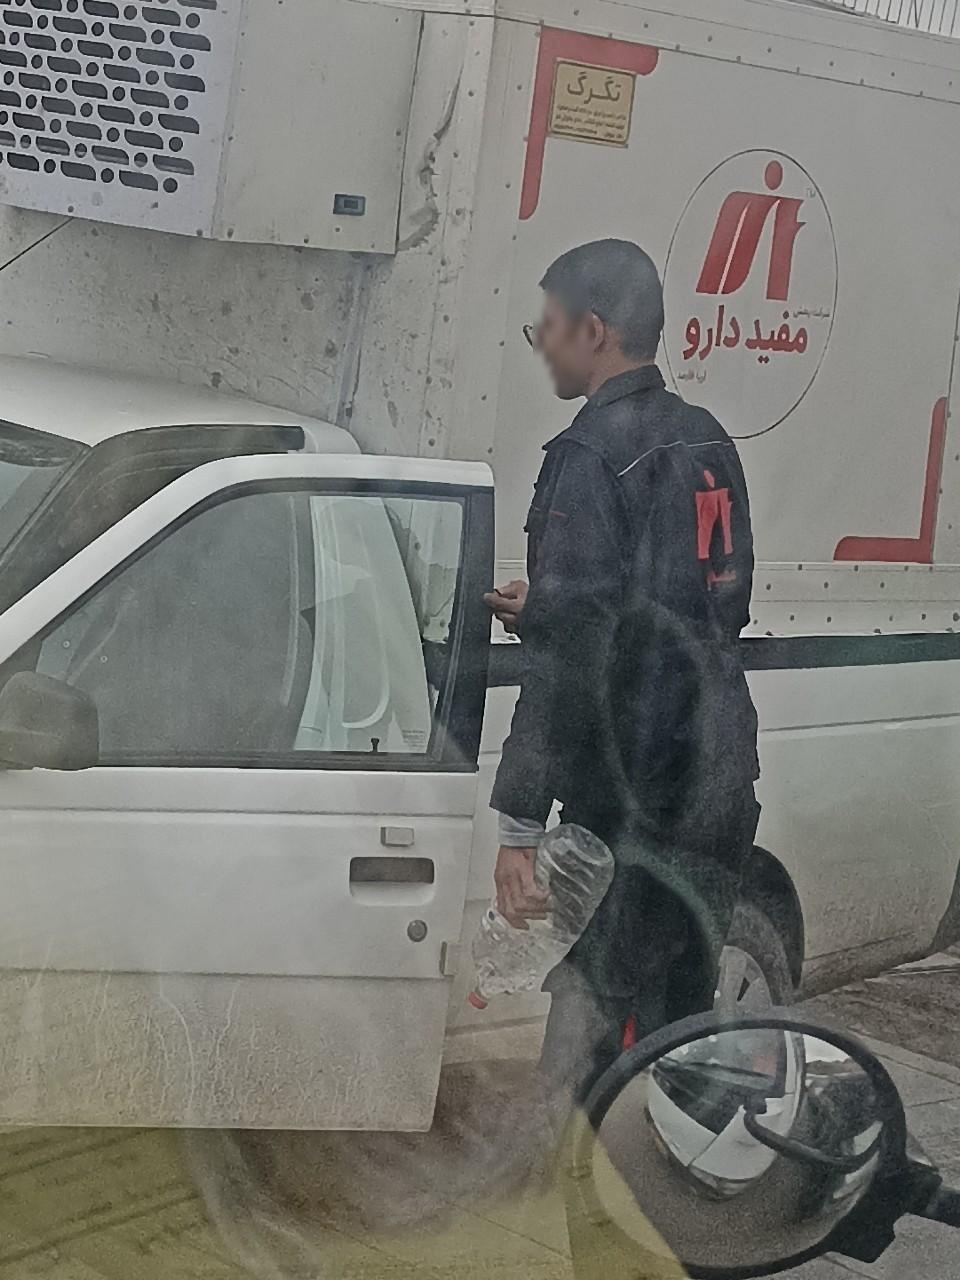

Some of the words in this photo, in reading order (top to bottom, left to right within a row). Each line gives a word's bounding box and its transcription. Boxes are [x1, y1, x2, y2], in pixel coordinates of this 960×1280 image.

[566, 70, 622, 104] تگرگ
[682, 304, 740, 361] دارو
[745, 310, 808, 364] مفید
